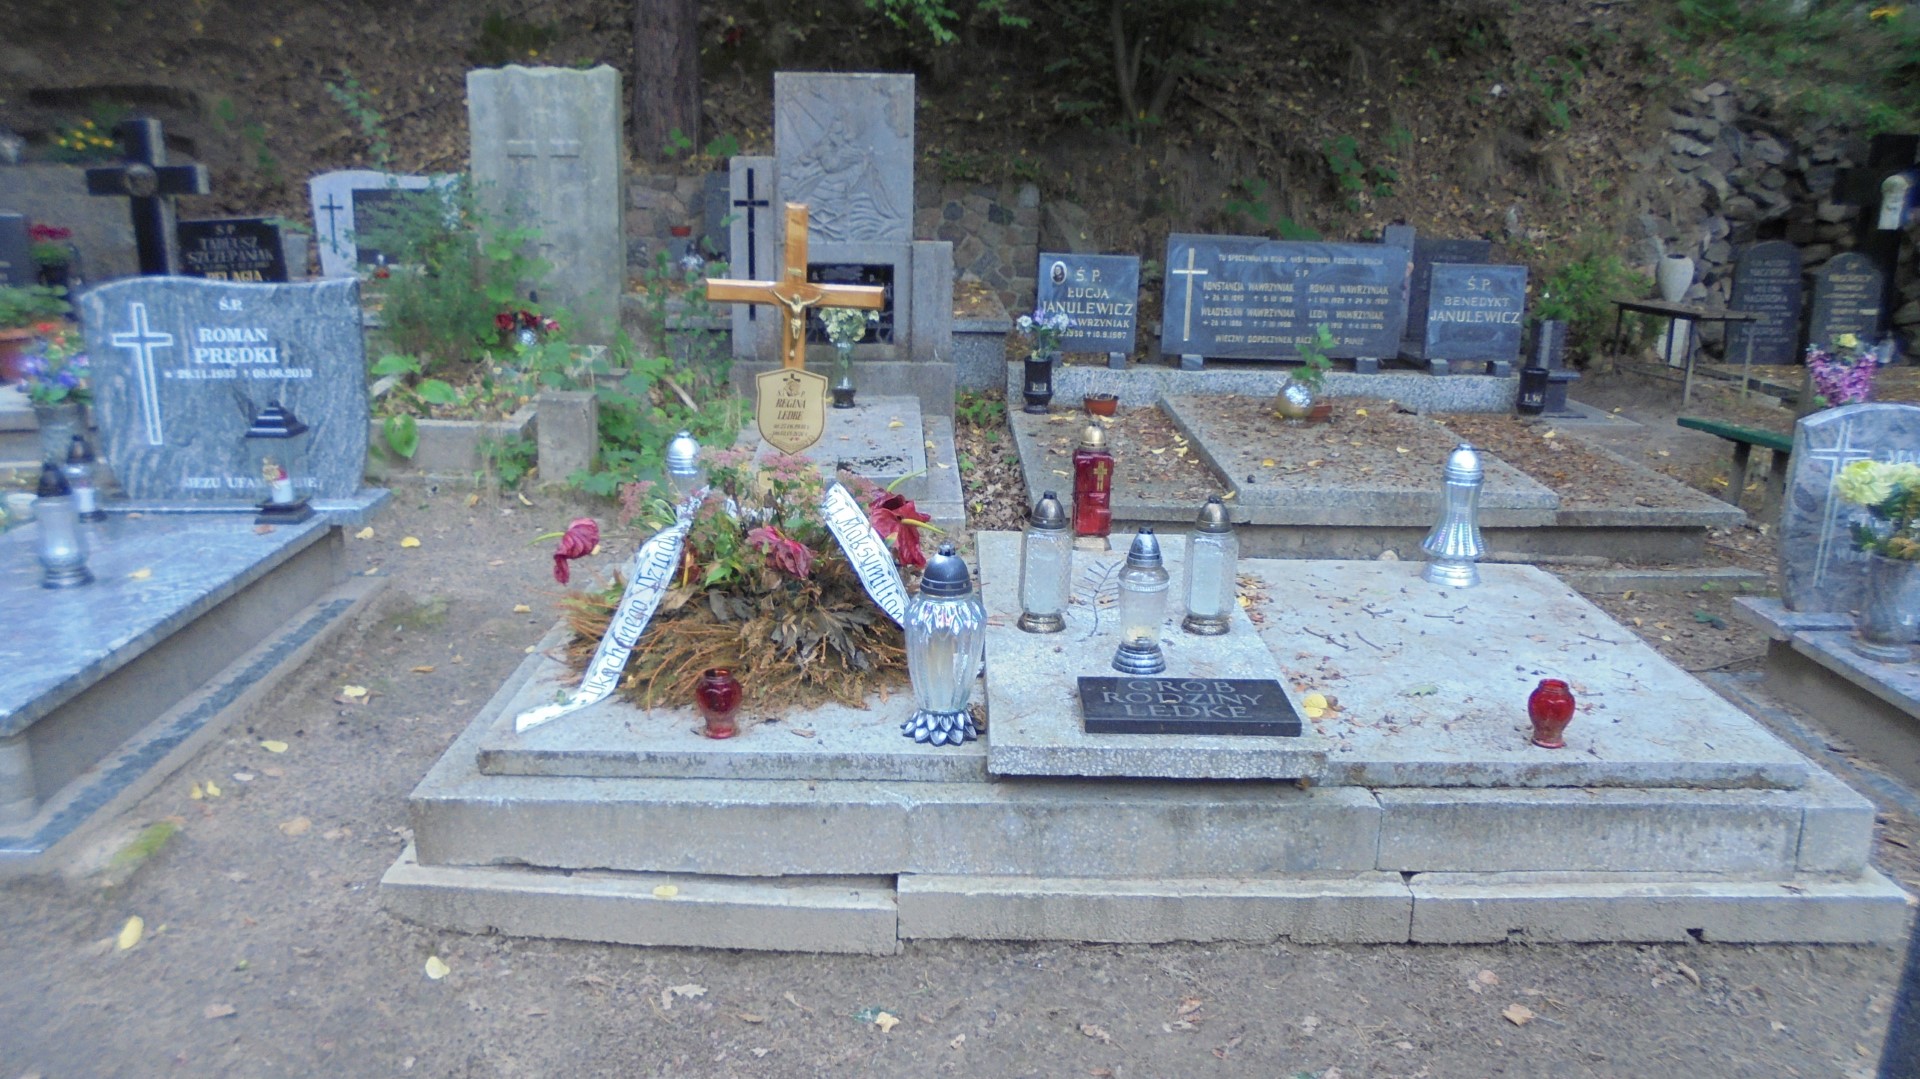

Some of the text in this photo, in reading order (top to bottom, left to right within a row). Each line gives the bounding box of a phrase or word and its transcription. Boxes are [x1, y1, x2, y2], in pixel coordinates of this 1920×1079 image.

[1067, 287, 1110, 299] ŁUCJA
[1043, 301, 1134, 316] JANULEWICZ
[1443, 296, 1510, 308] BENEDYKT
[1066, 317, 1130, 329] WRZYNIAK
[1430, 310, 1521, 324] JANULEWICZ
[199, 327, 269, 343] ROMAN
[193, 346, 280, 367] PRĘDKI
[775, 398, 806, 409] REGINA
[1103, 691, 1264, 706] RODZINY
[1124, 704, 1254, 719] LEDKE
